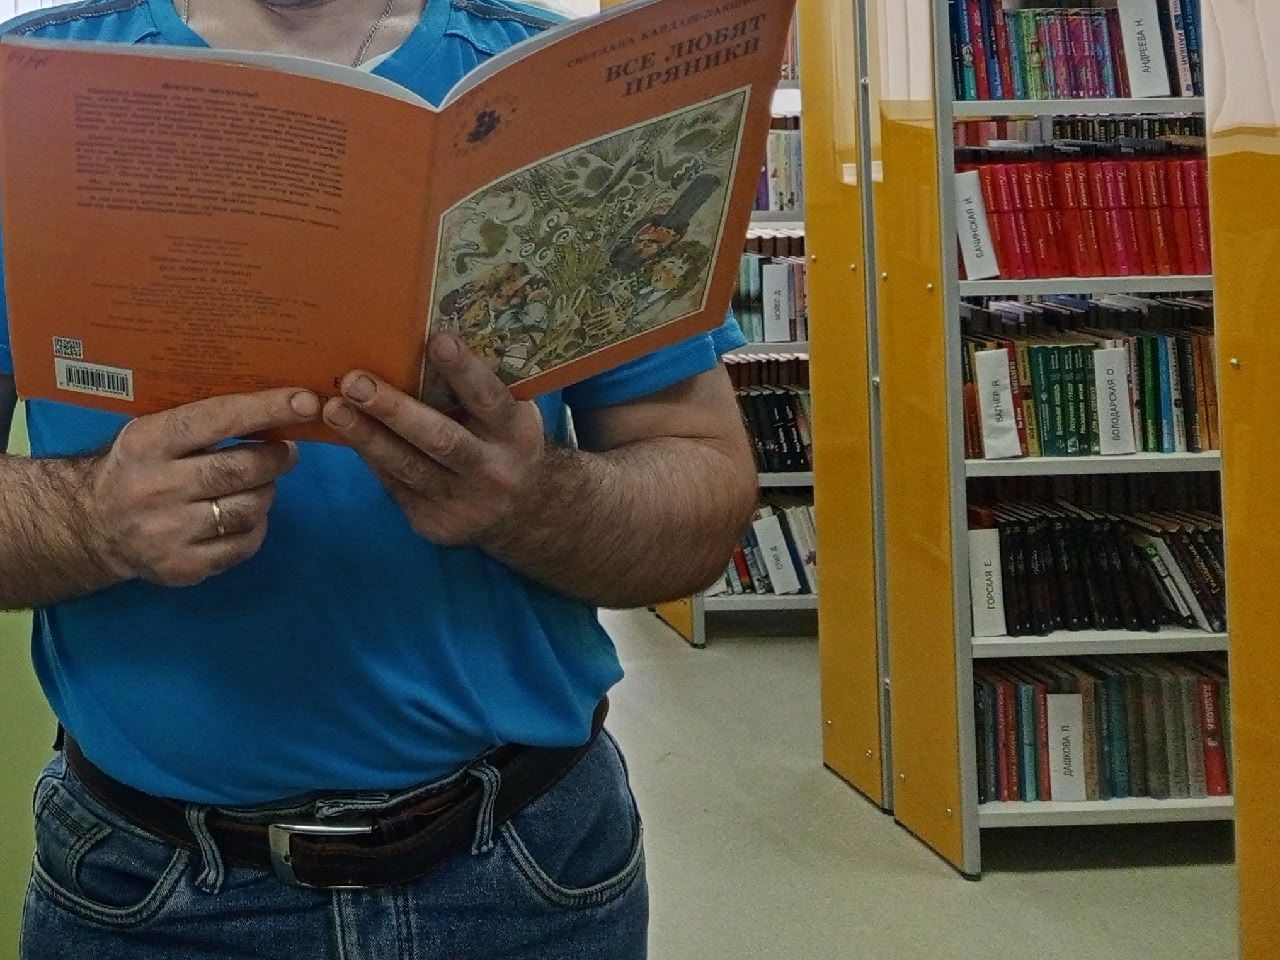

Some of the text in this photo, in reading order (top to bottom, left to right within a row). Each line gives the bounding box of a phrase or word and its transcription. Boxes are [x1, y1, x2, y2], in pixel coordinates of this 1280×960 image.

[605, 13, 767, 83] ВСЕ ЛЮБЯТ
[624, 37, 762, 96] ПРЯНИКИ
[1136, 30, 1151, 72] АНДРЕЕВА
[993, 391, 1004, 422] ВАГНЕР
[1107, 380, 1121, 440] ВОЛОДАРСКАЯ
[985, 571, 995, 609] ГОРСКАЯ
[1062, 736, 1074, 777] ДАШКОВА
